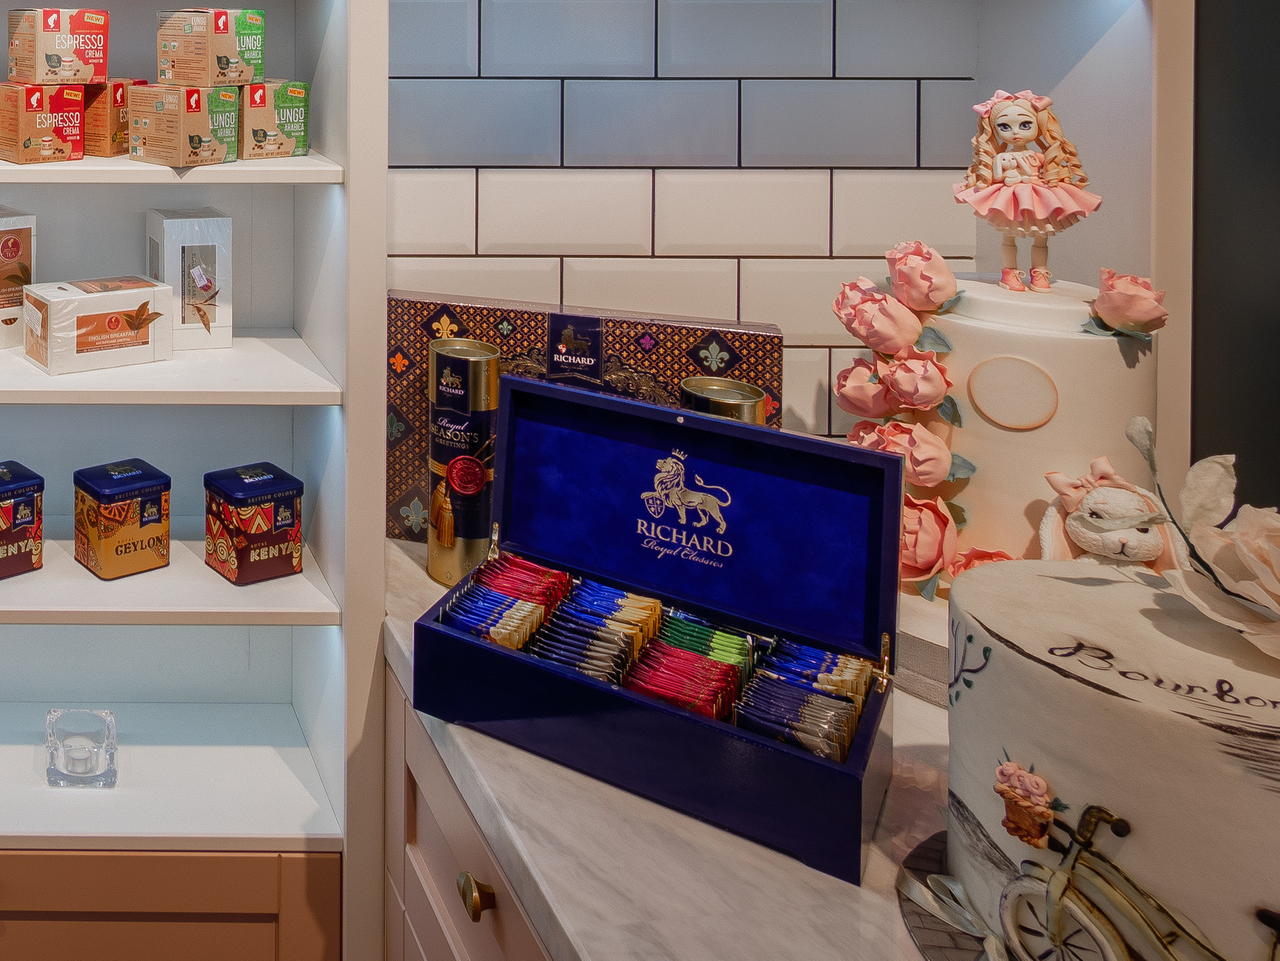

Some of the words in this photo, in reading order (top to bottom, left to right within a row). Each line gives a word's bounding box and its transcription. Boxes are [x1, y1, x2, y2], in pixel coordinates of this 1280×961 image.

[86, 15, 103, 23] NEW!
[248, 15, 261, 23] NEW!
[55, 35, 104, 50] ESPRESSO
[237, 35, 262, 50] LUNGO
[85, 50, 104, 58] CREMA
[244, 51, 262, 59] ARABICA
[65, 91, 81, 100] NEW!
[221, 93, 234, 101] NEW!
[289, 89, 304, 97] NEW!
[36, 112, 81, 128] ESPRESSO
[209, 112, 235, 129] LUNGO
[275, 108, 305, 123] LUNGO
[217, 128, 235, 137] ARABICA
[284, 123, 305, 131] ARABICA
[554, 353, 595, 365] RICHARD
[439, 385, 464, 395] RICHARD
[436, 416, 468, 434] Royal
[430, 423, 479, 443] SEASON'S
[435, 438, 470, 449] GREETINGS
[113, 470, 142, 480] RICHARD
[244, 474, 274, 484] RICHARD
[14, 486, 38, 496] COLONY
[115, 491, 139, 500] BRITISH
[141, 485, 165, 494] COLONY
[247, 494, 272, 504] BRITISH
[273, 490, 298, 499] COLONY
[636, 518, 733, 557] RICHARD
[250, 541, 295, 562] KENYA
[641, 538, 679, 558] Royal
[681, 548, 723, 568] Classics
